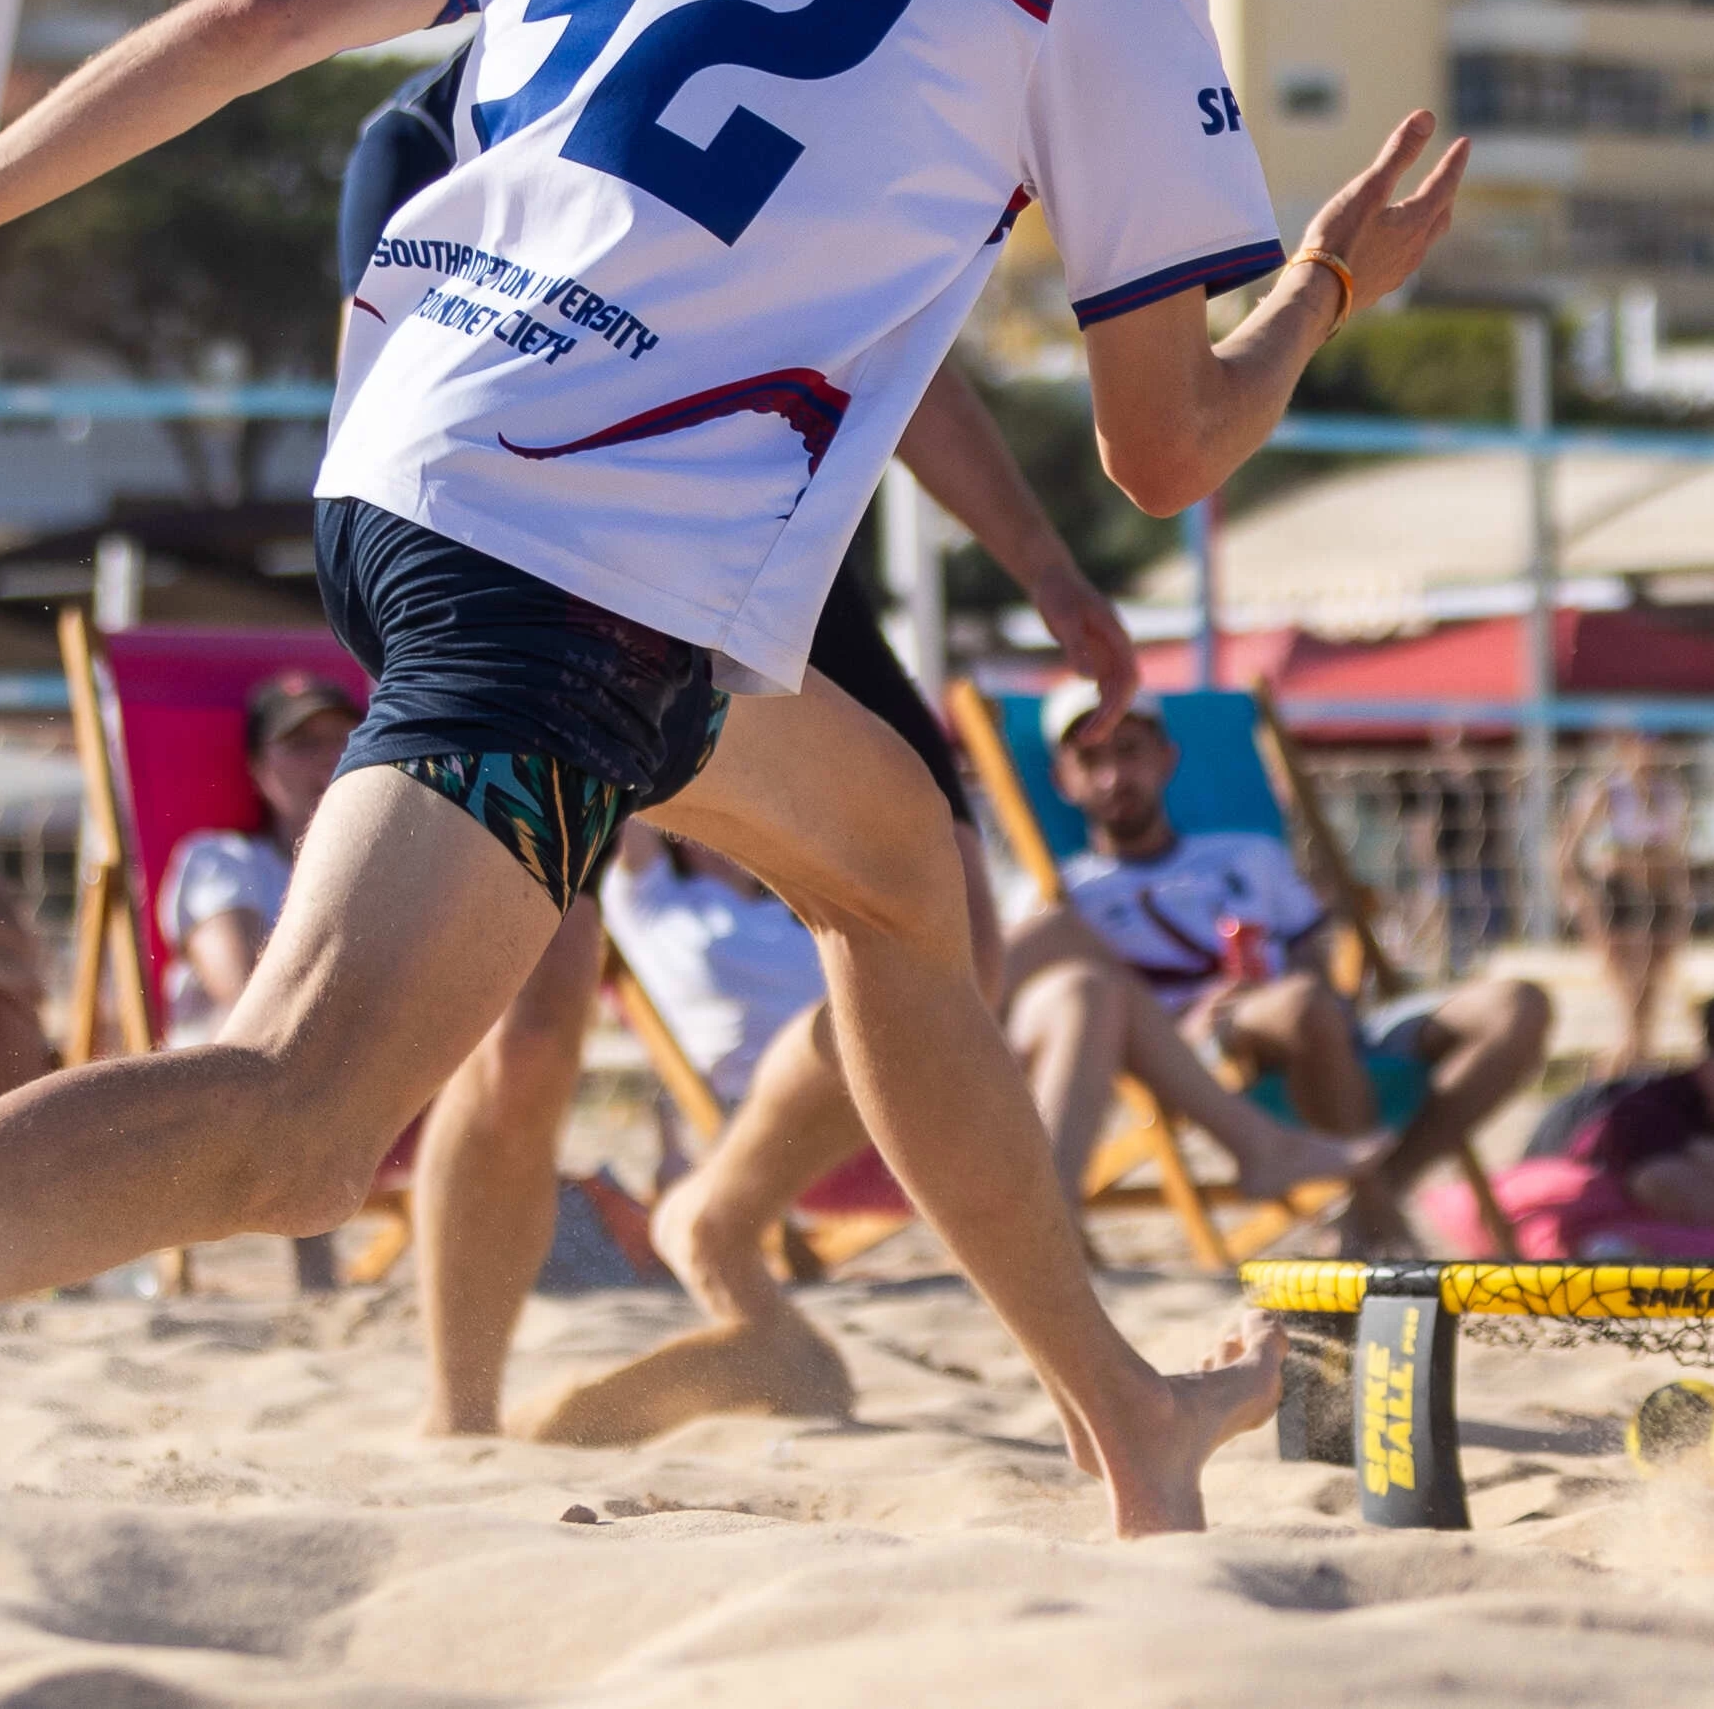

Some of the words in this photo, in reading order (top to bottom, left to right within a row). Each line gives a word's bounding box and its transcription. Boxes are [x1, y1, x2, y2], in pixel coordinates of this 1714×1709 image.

[372, 238, 536, 300] SOUTHAMPTON
[527, 274, 660, 361] VERSITY
[493, 309, 578, 365] CIETY
[1363, 1341, 1391, 1498] SPIKE
[1387, 1361, 1416, 1491] BALL
